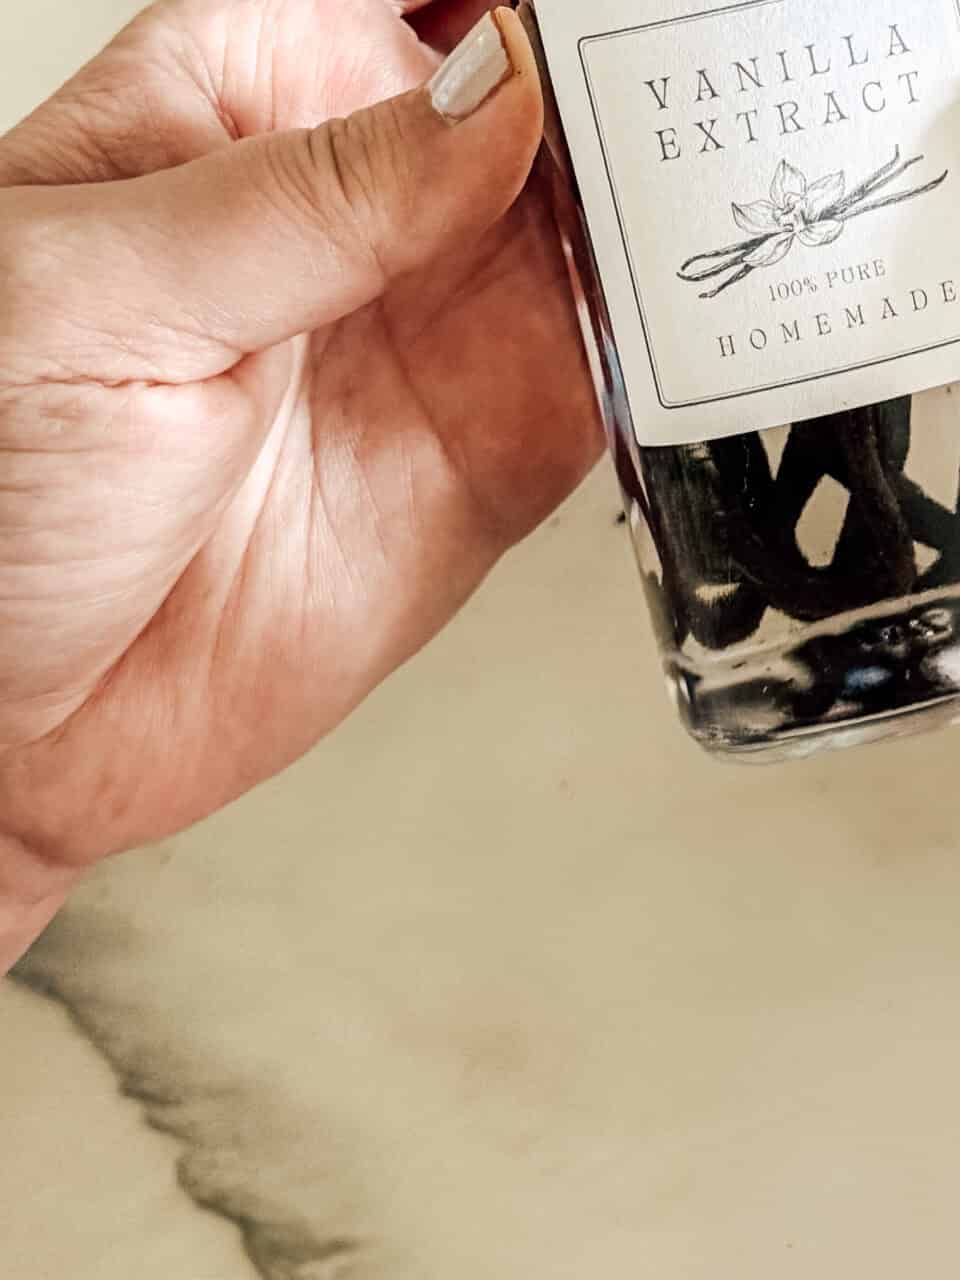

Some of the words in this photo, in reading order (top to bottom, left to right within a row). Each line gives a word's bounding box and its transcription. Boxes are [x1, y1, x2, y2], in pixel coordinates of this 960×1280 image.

[643, 22, 913, 112] VANILLA
[654, 70, 923, 163] EXTRACT
[718, 279, 960, 359] HOMEMADE
[767, 275, 819, 304] 100%
[826, 258, 888, 291] PURE
